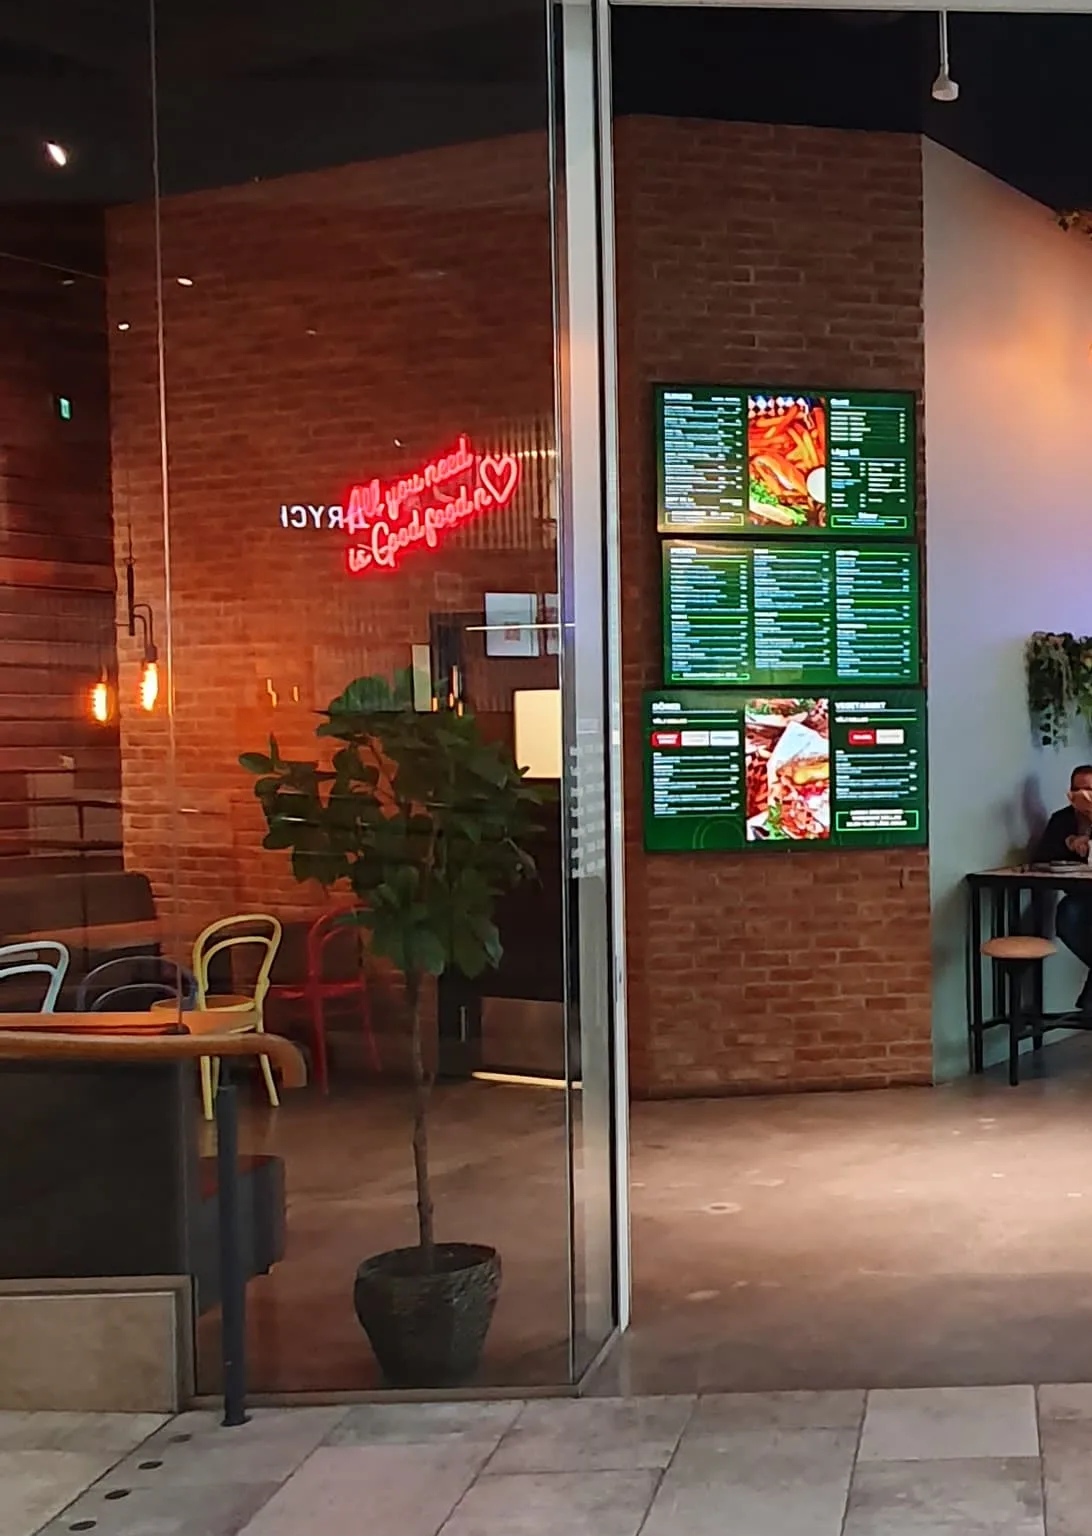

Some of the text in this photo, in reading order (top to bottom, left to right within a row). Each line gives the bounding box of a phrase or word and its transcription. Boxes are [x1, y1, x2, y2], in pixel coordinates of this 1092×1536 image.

[385, 474, 425, 520] you
[424, 434, 474, 486] need
[371, 511, 425, 567] Good
[424, 487, 473, 547] food
